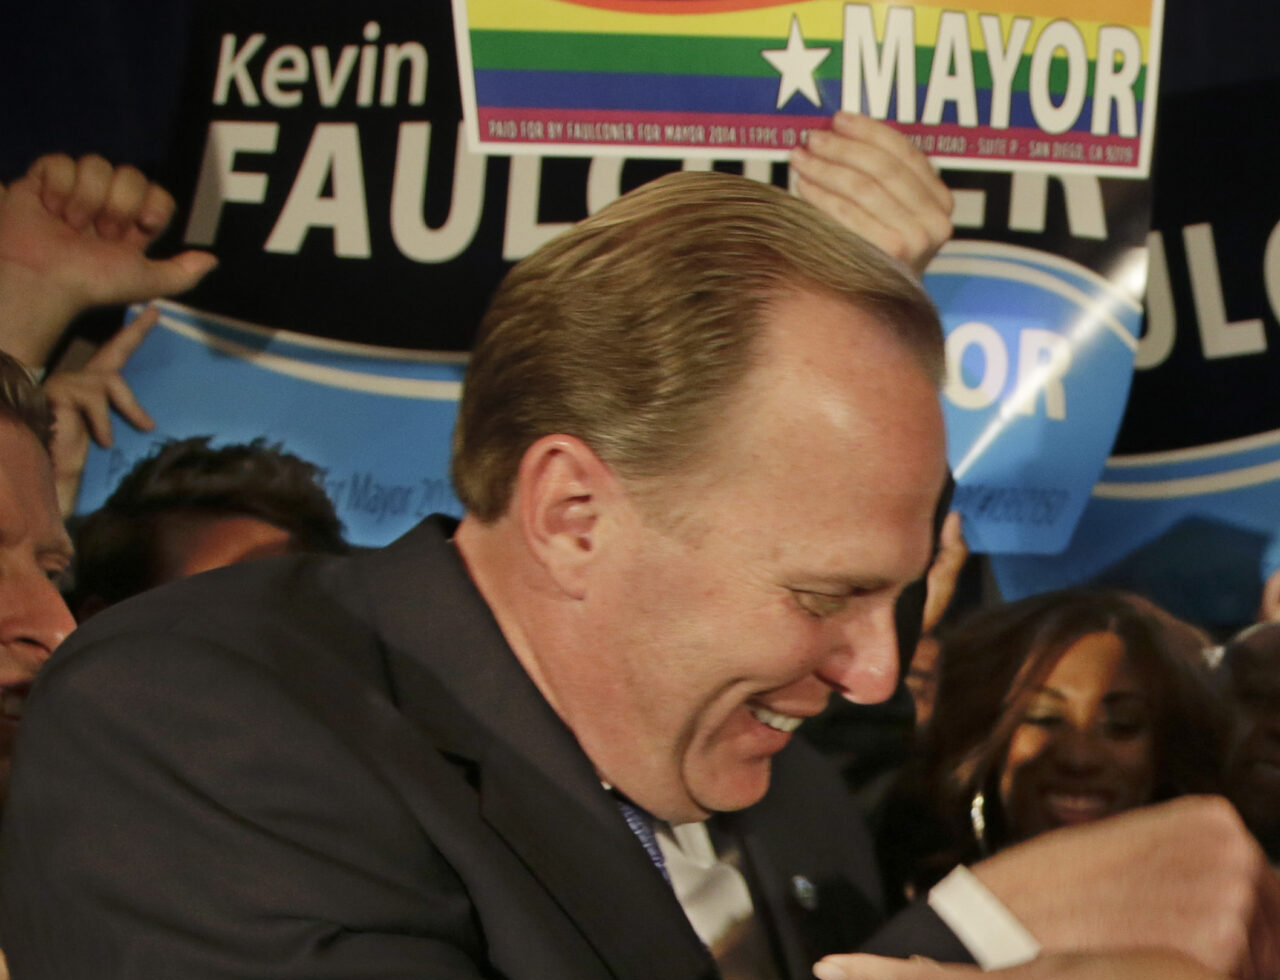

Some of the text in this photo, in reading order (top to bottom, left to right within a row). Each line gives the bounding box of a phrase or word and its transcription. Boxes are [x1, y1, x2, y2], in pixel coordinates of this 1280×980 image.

[212, 20, 429, 107] Kevin
[840, 2, 1142, 138] MAYOR
[489, 120, 517, 138] PAID
[521, 121, 543, 139] FOR
[547, 121, 563, 139] BY
[638, 123, 661, 142] FOR
[664, 125, 705, 143] MAYOR
